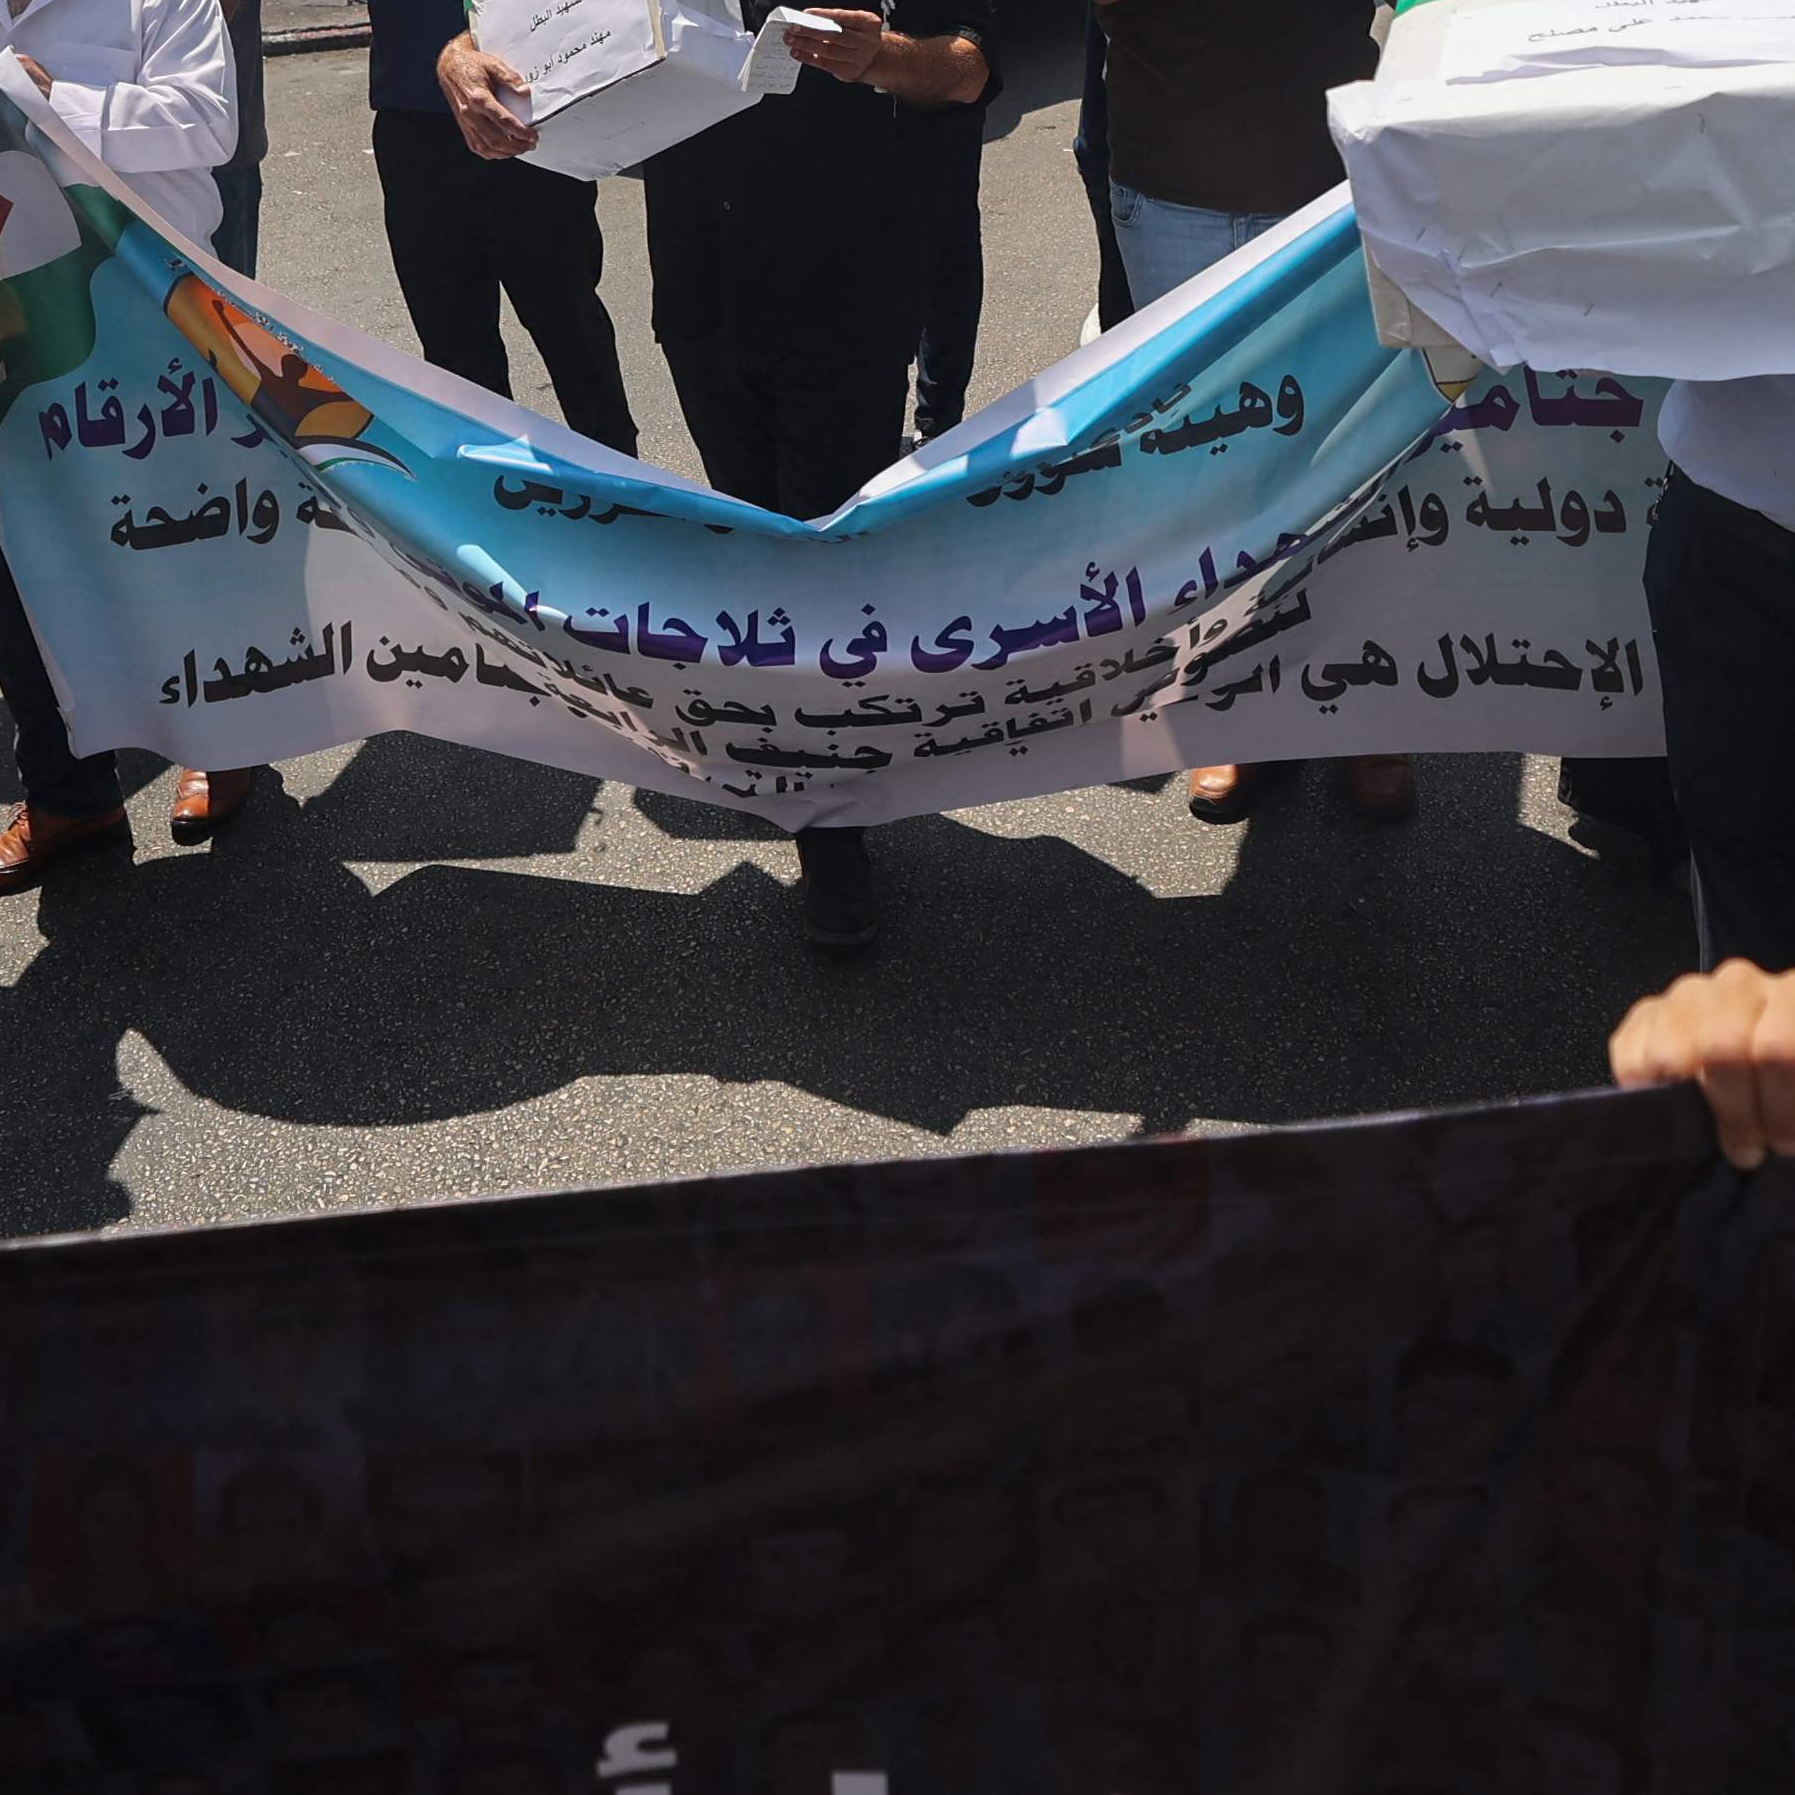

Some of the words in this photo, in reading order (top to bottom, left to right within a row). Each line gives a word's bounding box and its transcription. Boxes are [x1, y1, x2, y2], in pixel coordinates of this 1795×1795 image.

[530, 9, 553, 33] البطل
[557, 43, 587, 64] محمود
[590, 30, 612, 46] مهند
[38, 357, 219, 460] الأرقام
[110, 476, 280, 551] واضحة
[1465, 473, 1628, 549] دولية
[562, 601, 798, 671] ثلاجات
[818, 603, 888, 690] في
[910, 560, 1147, 673] الأسرى
[159, 620, 353, 709] الشهداء
[1301, 639, 1400, 715] هي
[1416, 631, 1645, 712] الإحتلال
[674, 687, 777, 734] بحق
[794, 689, 985, 737] ترتكب
[913, 700, 1092, 760] اتفاقية
[725, 737, 895, 774] جنيف
